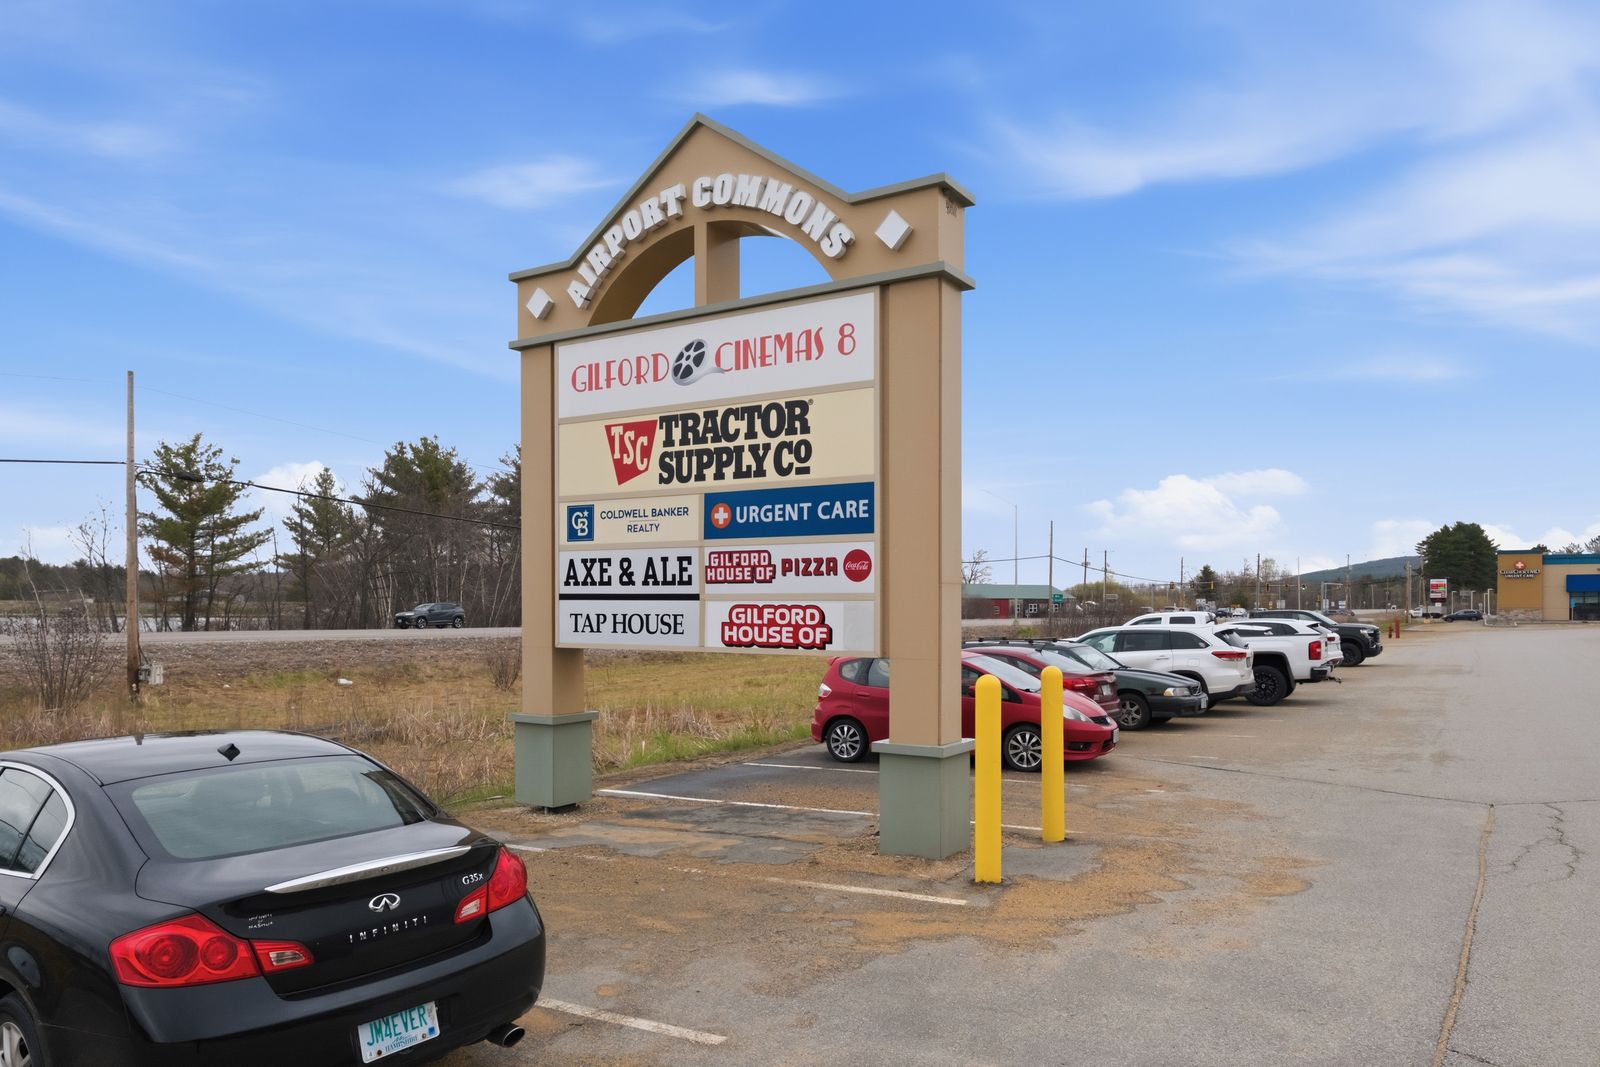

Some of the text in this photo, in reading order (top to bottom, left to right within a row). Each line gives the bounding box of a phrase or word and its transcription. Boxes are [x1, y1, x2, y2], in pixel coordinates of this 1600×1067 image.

[567, 173, 855, 309] AIRPORT COMMONS
[571, 322, 857, 393] GILFORD CINEMAS 8
[658, 399, 811, 448] TRACTOR
[610, 425, 649, 471] TSC
[658, 442, 772, 485] SUPPLY
[600, 506, 689, 520] COLDWELL BANKER
[736, 499, 869, 524] URGENT CARE
[626, 523, 660, 533] REALTY
[563, 555, 693, 586] AXE & ALE
[710, 552, 769, 567] GILFORD
[781, 557, 839, 577] PIZZA
[707, 566, 775, 581] HOUSE OF
[569, 613, 685, 635] TAP HOUSE
[731, 607, 820, 625] GILFORD
[723, 626, 829, 645] HOUSE OF
[349, 915, 427, 943] INFINITI
[366, 1005, 428, 1047] JM4EVER
